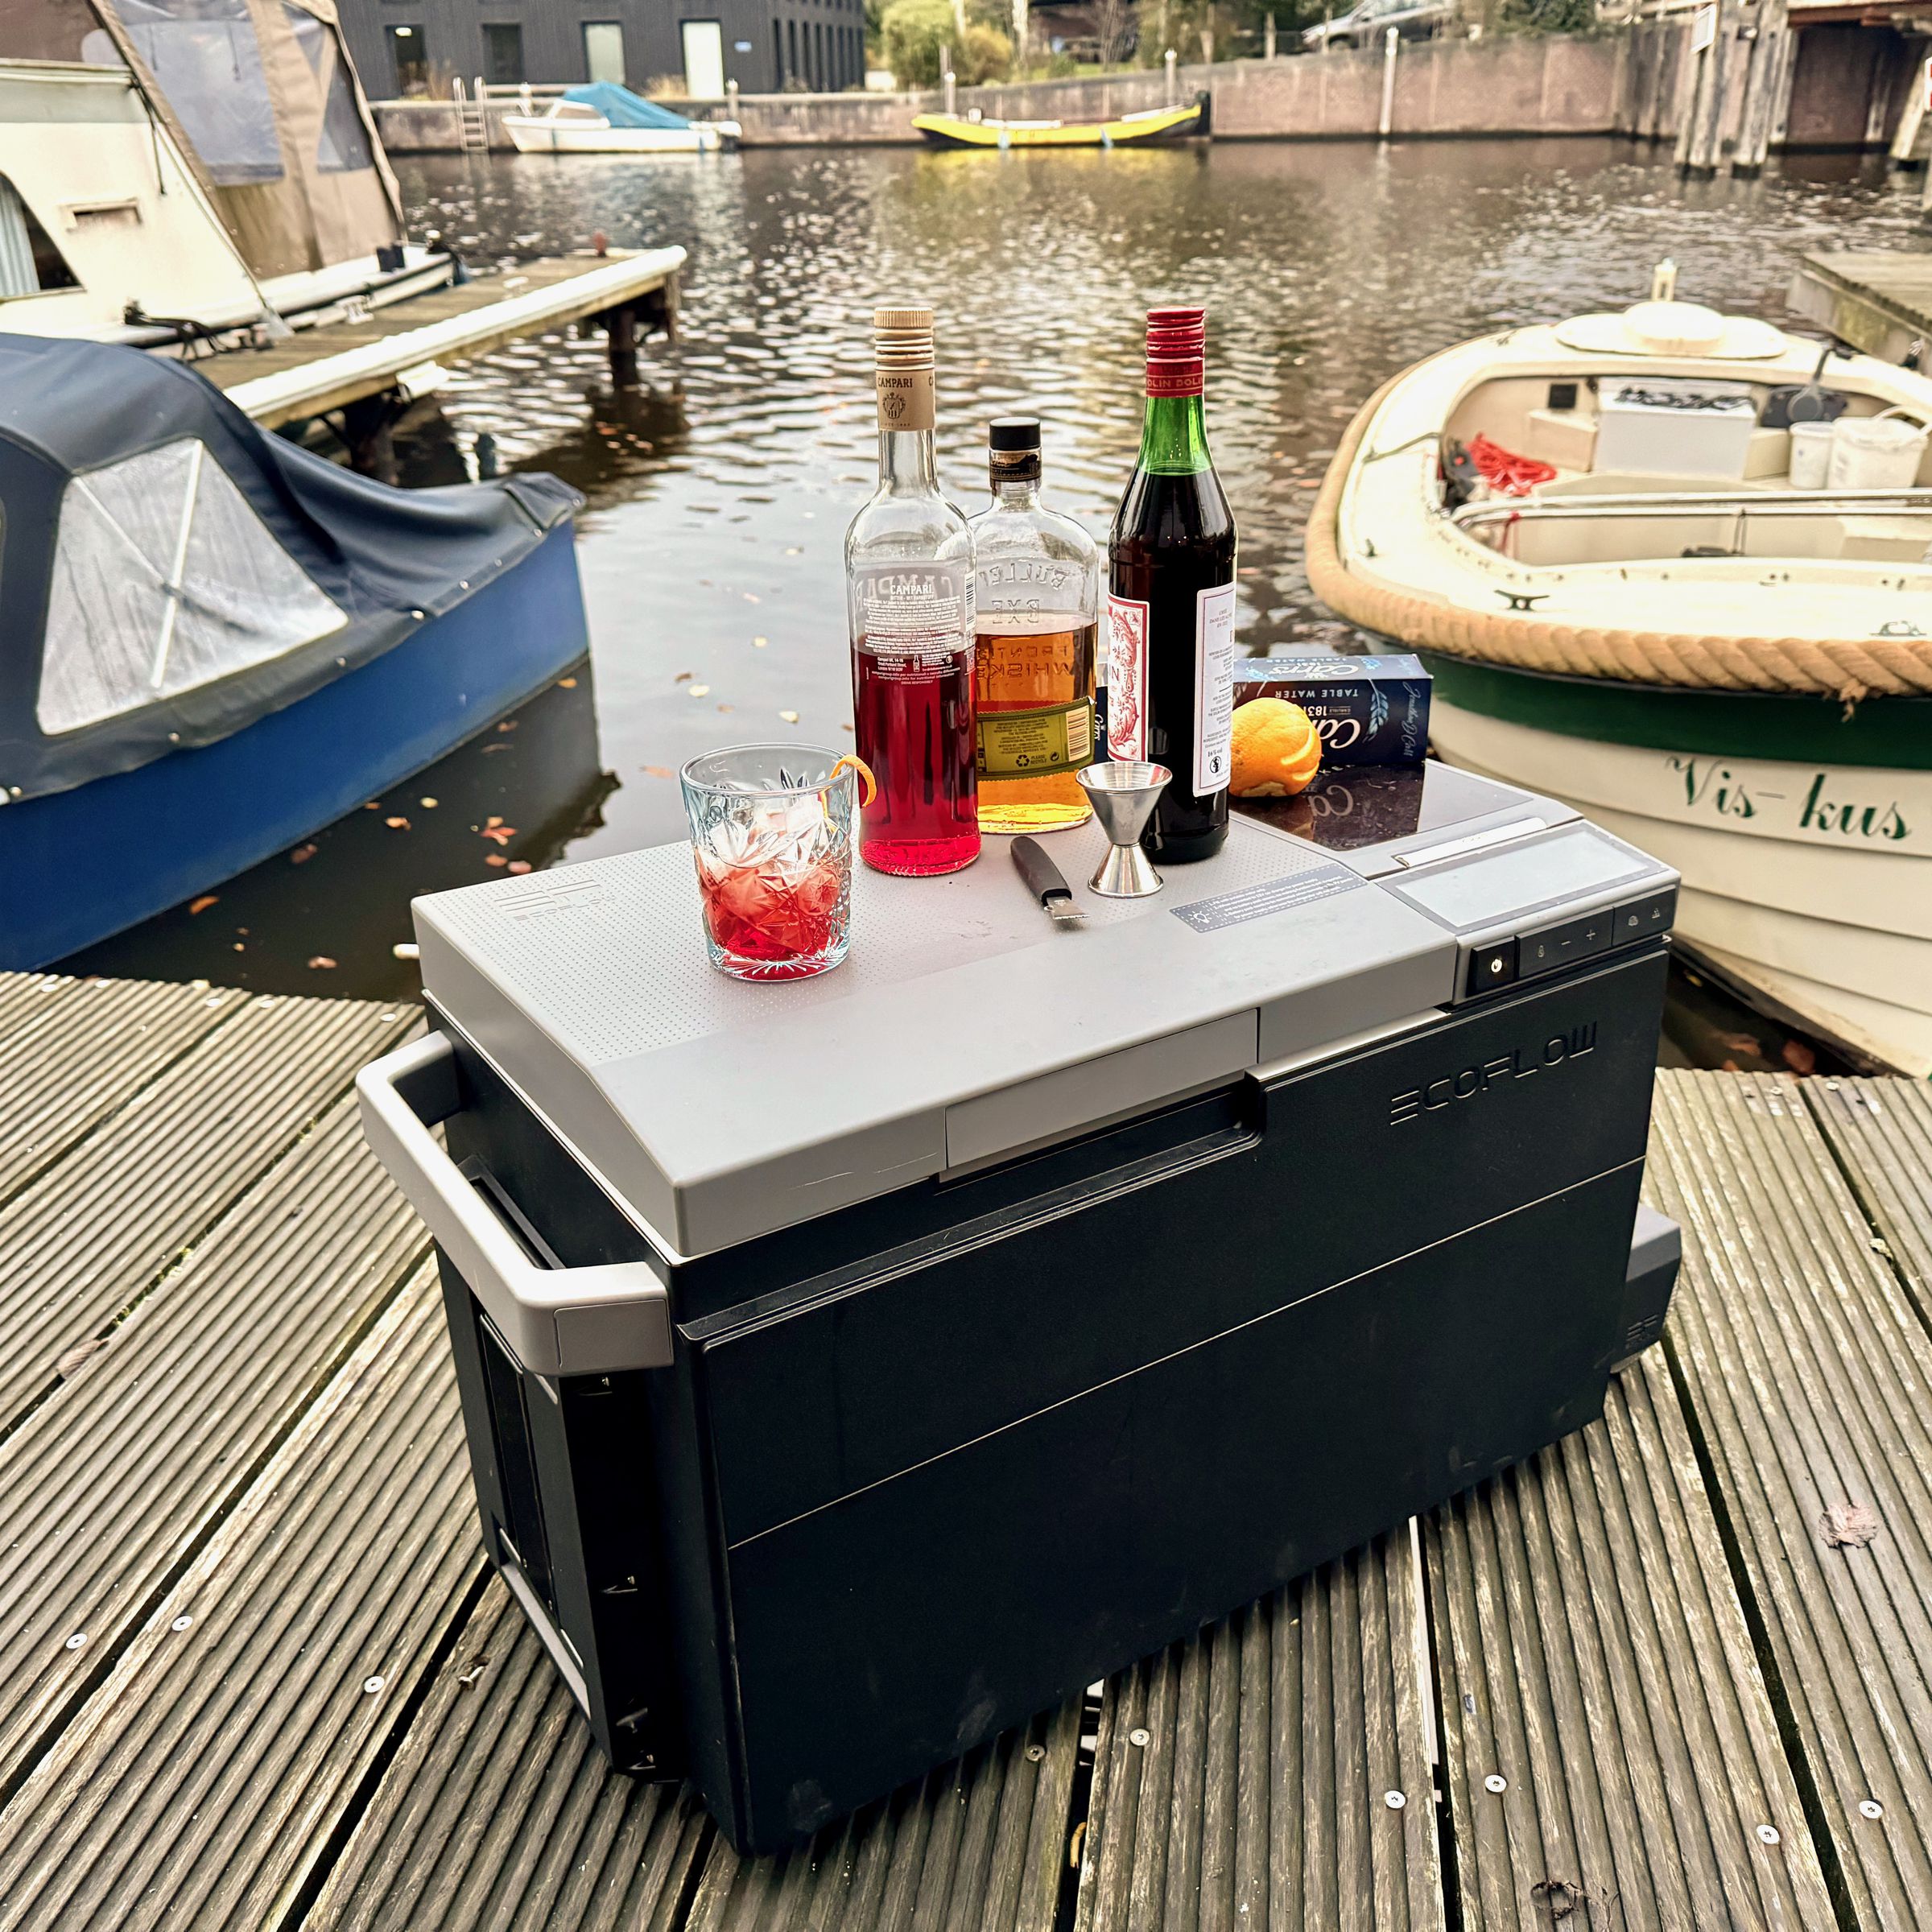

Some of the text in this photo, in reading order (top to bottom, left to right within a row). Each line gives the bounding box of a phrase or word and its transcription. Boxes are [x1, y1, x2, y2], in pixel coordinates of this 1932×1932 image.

[877, 378, 913, 388] CAMPARI
[1148, 379, 1171, 387] OLIN
[890, 584, 932, 594] CAMPARI
[1275, 689, 1359, 698] TABLE WATER
[1312, 718, 1360, 749] Ca
[1390, 1021, 1598, 1126] ECOFLOW
